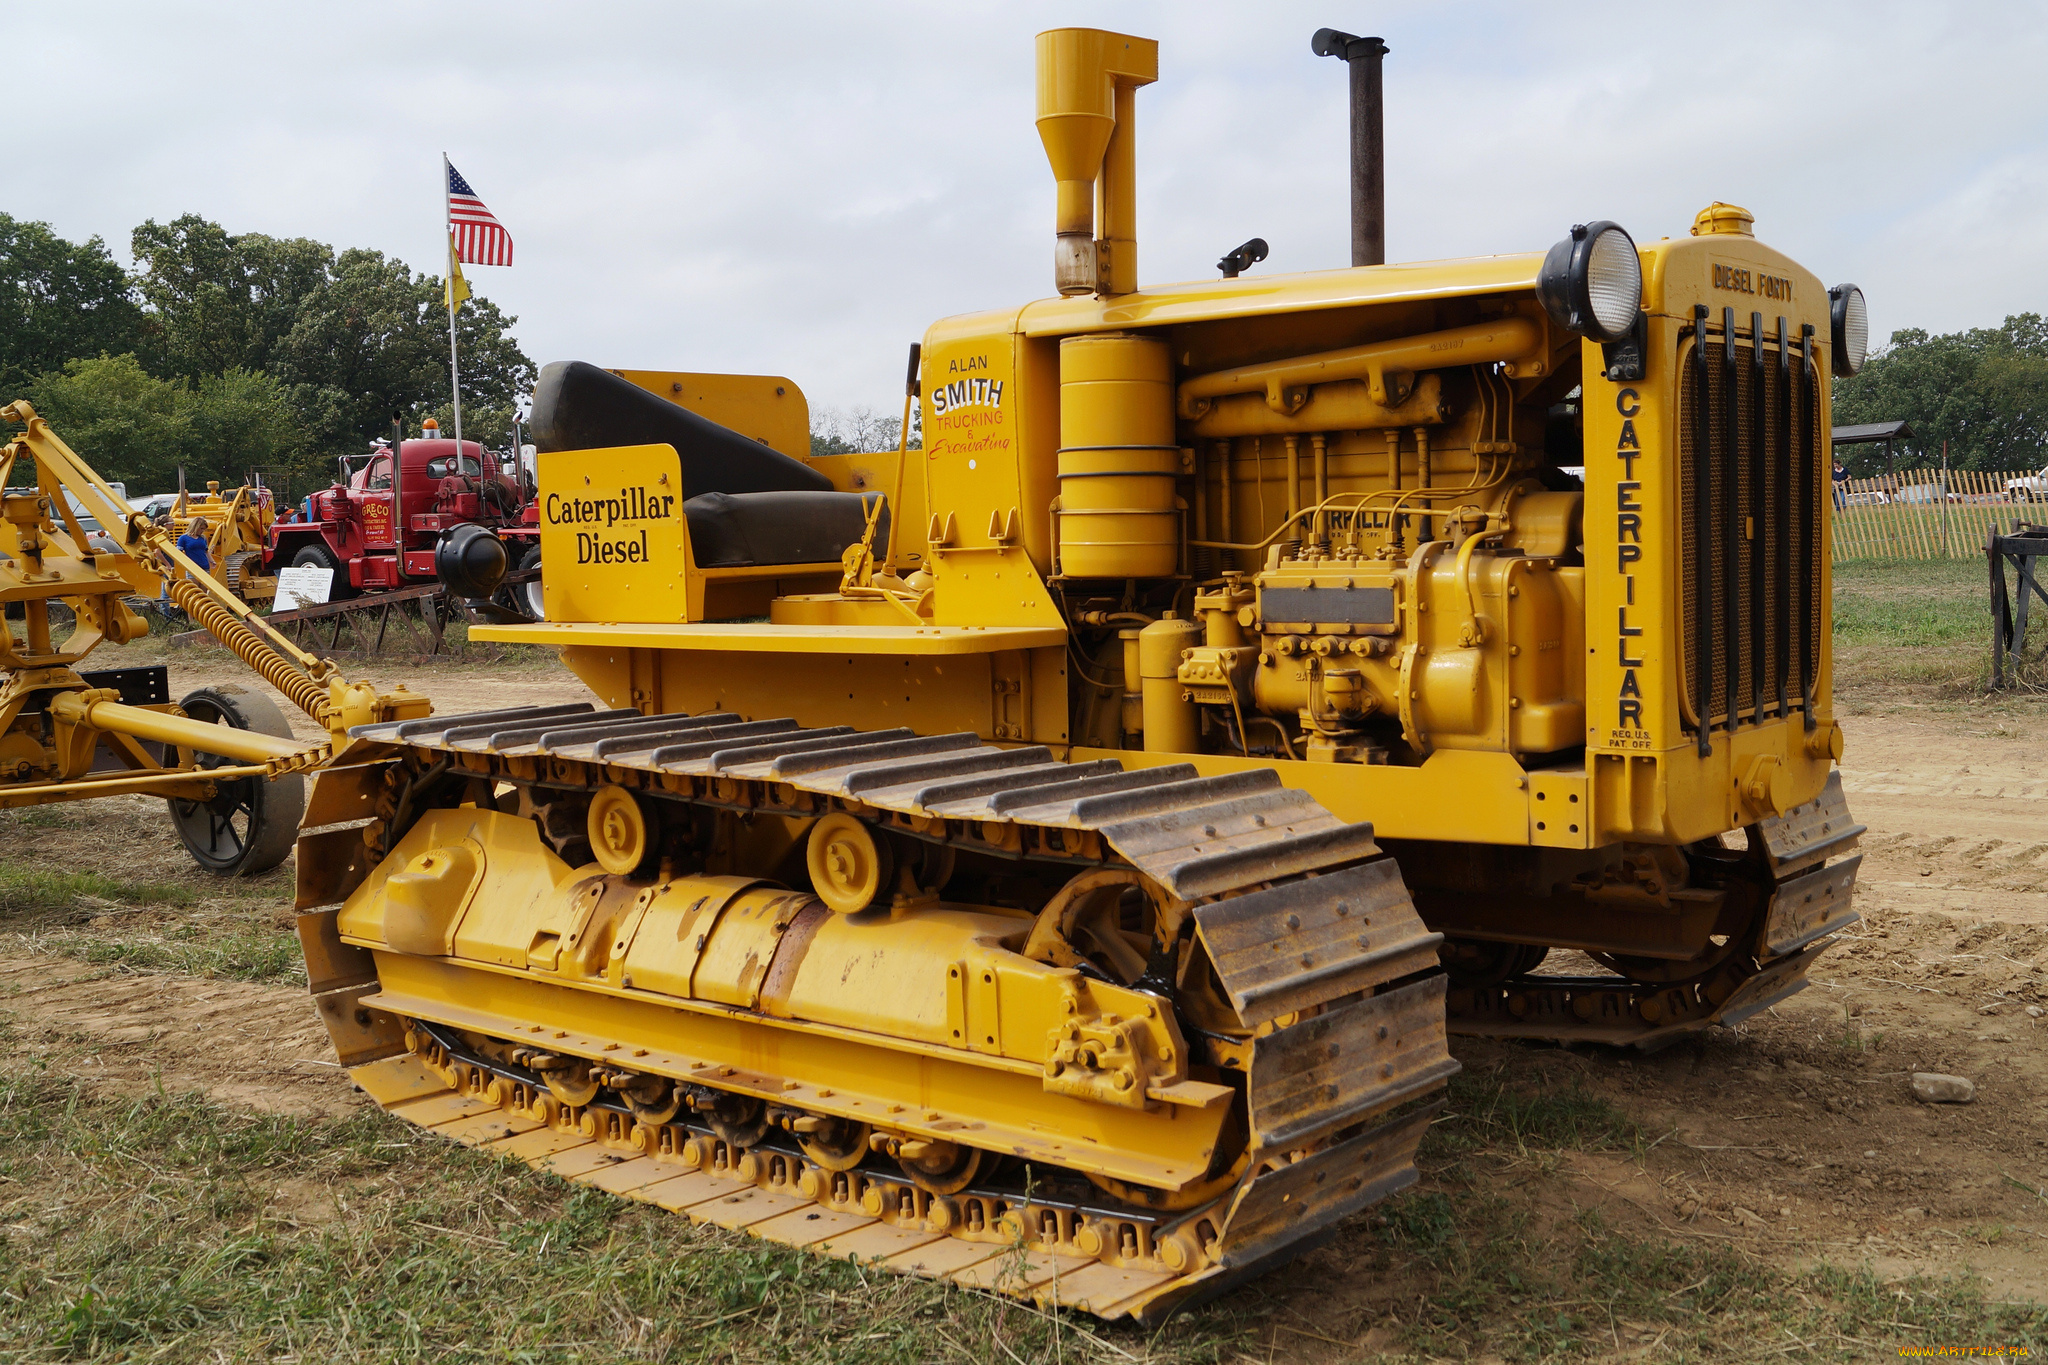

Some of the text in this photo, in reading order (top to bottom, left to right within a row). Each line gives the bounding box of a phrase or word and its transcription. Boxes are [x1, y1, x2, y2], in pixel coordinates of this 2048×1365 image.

[1713, 262, 1793, 302] DIESEL FORTY
[949, 355, 987, 374] ALAN
[931, 378, 1004, 416] SMITH
[936, 410, 1003, 430] TRUCKING
[928, 431, 1011, 461] Excavating
[967, 429, 974, 440] &
[361, 503, 389, 518] GRECO
[546, 486, 675, 528] Caterpillar
[576, 529, 650, 565] Diesel
[1616, 388, 1642, 729] CATERPILLAR
[1609, 739, 1628, 748] PAT.
[1612, 730, 1634, 739] REG.
